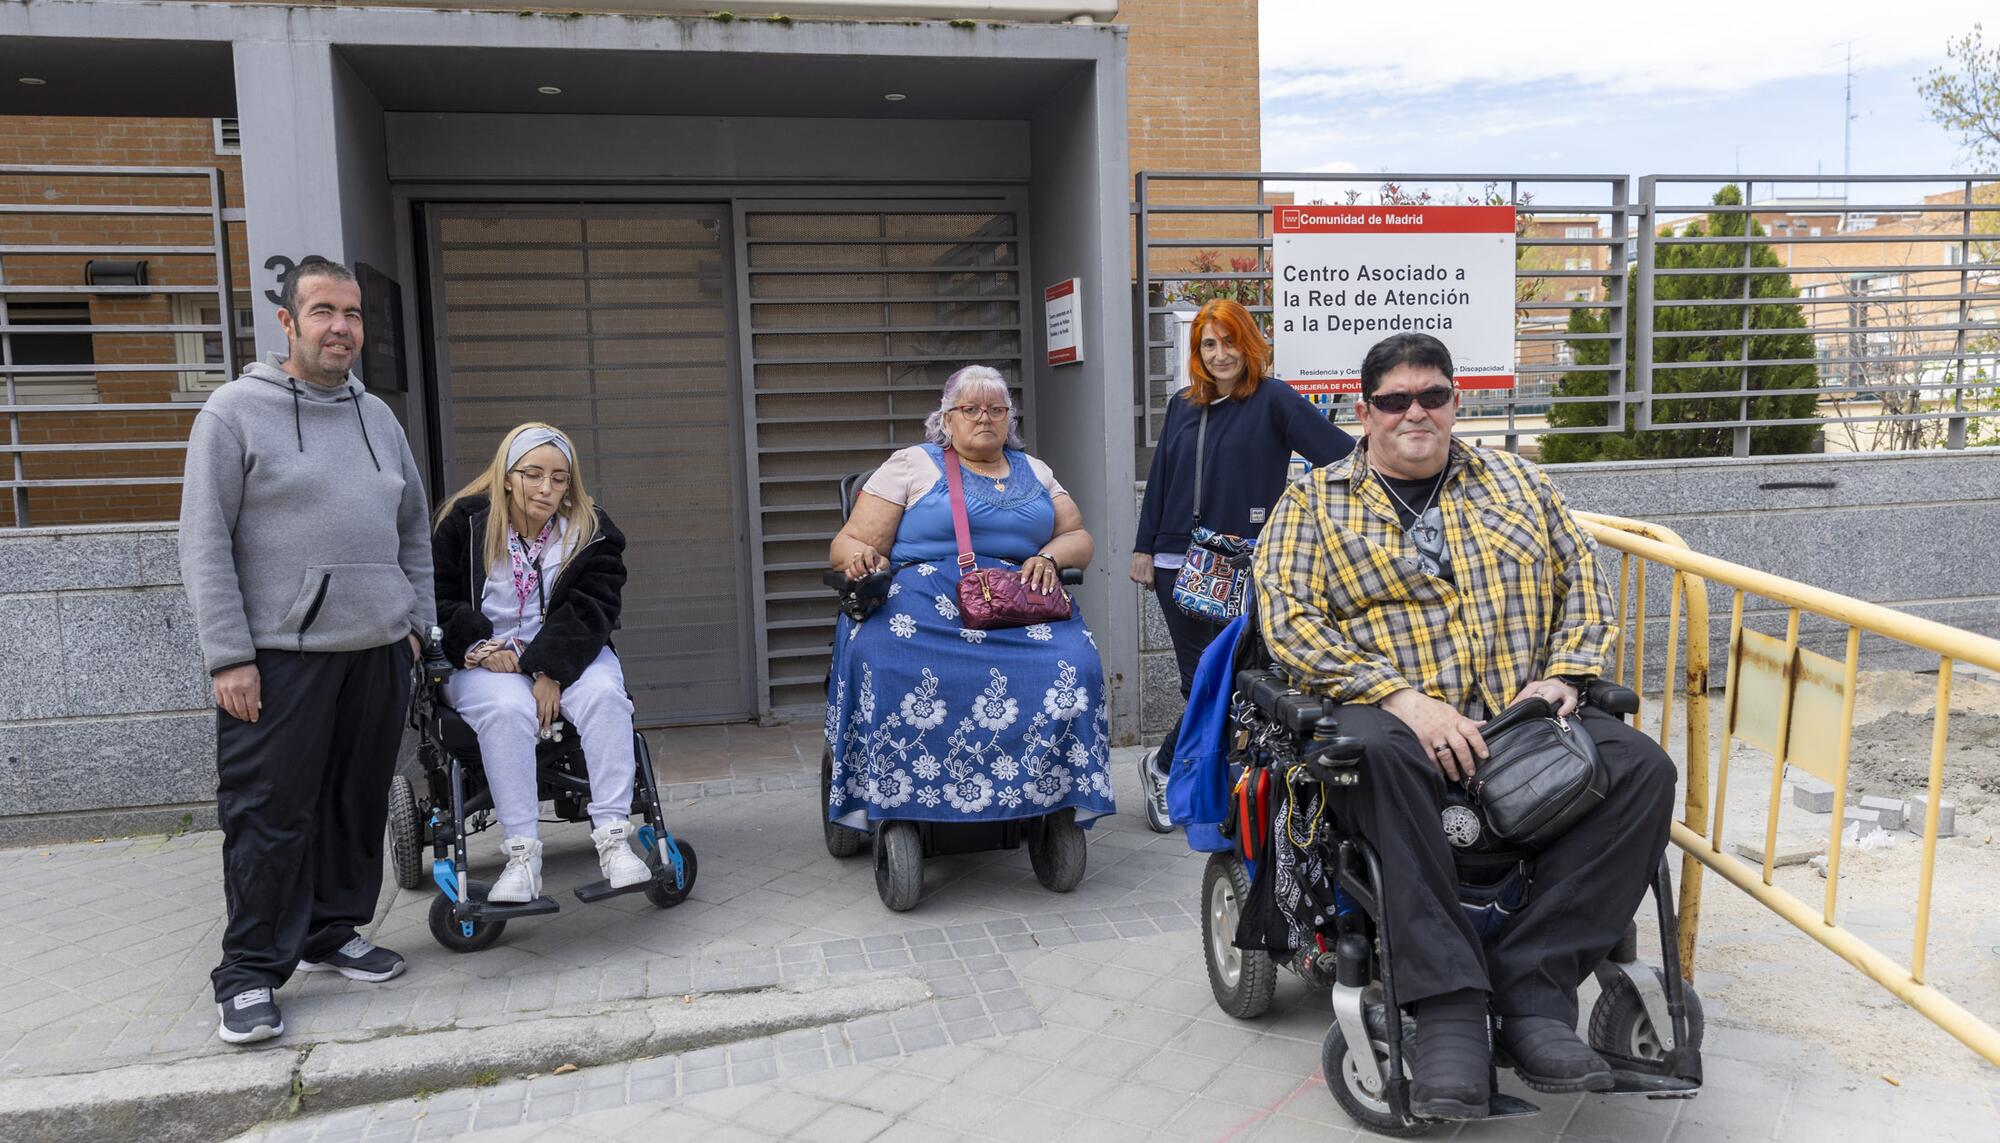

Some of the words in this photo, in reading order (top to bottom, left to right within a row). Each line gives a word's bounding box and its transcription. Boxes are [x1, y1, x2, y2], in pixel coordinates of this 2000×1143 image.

[1300, 214, 1364, 225] Comunidad
[1368, 214, 1382, 225] de
[1385, 214, 1423, 225] Madrid
[1283, 265, 1350, 282] Centro
[1356, 264, 1448, 282] Asociado
[1455, 268, 1465, 281] a
[1284, 290, 1300, 307] la
[1309, 290, 1346, 307] Red
[1354, 290, 1377, 306] de
[1384, 288, 1470, 306] Atención
[1283, 319, 1294, 332] a
[1303, 315, 1319, 332] la
[1327, 313, 1453, 335] Dependencia
